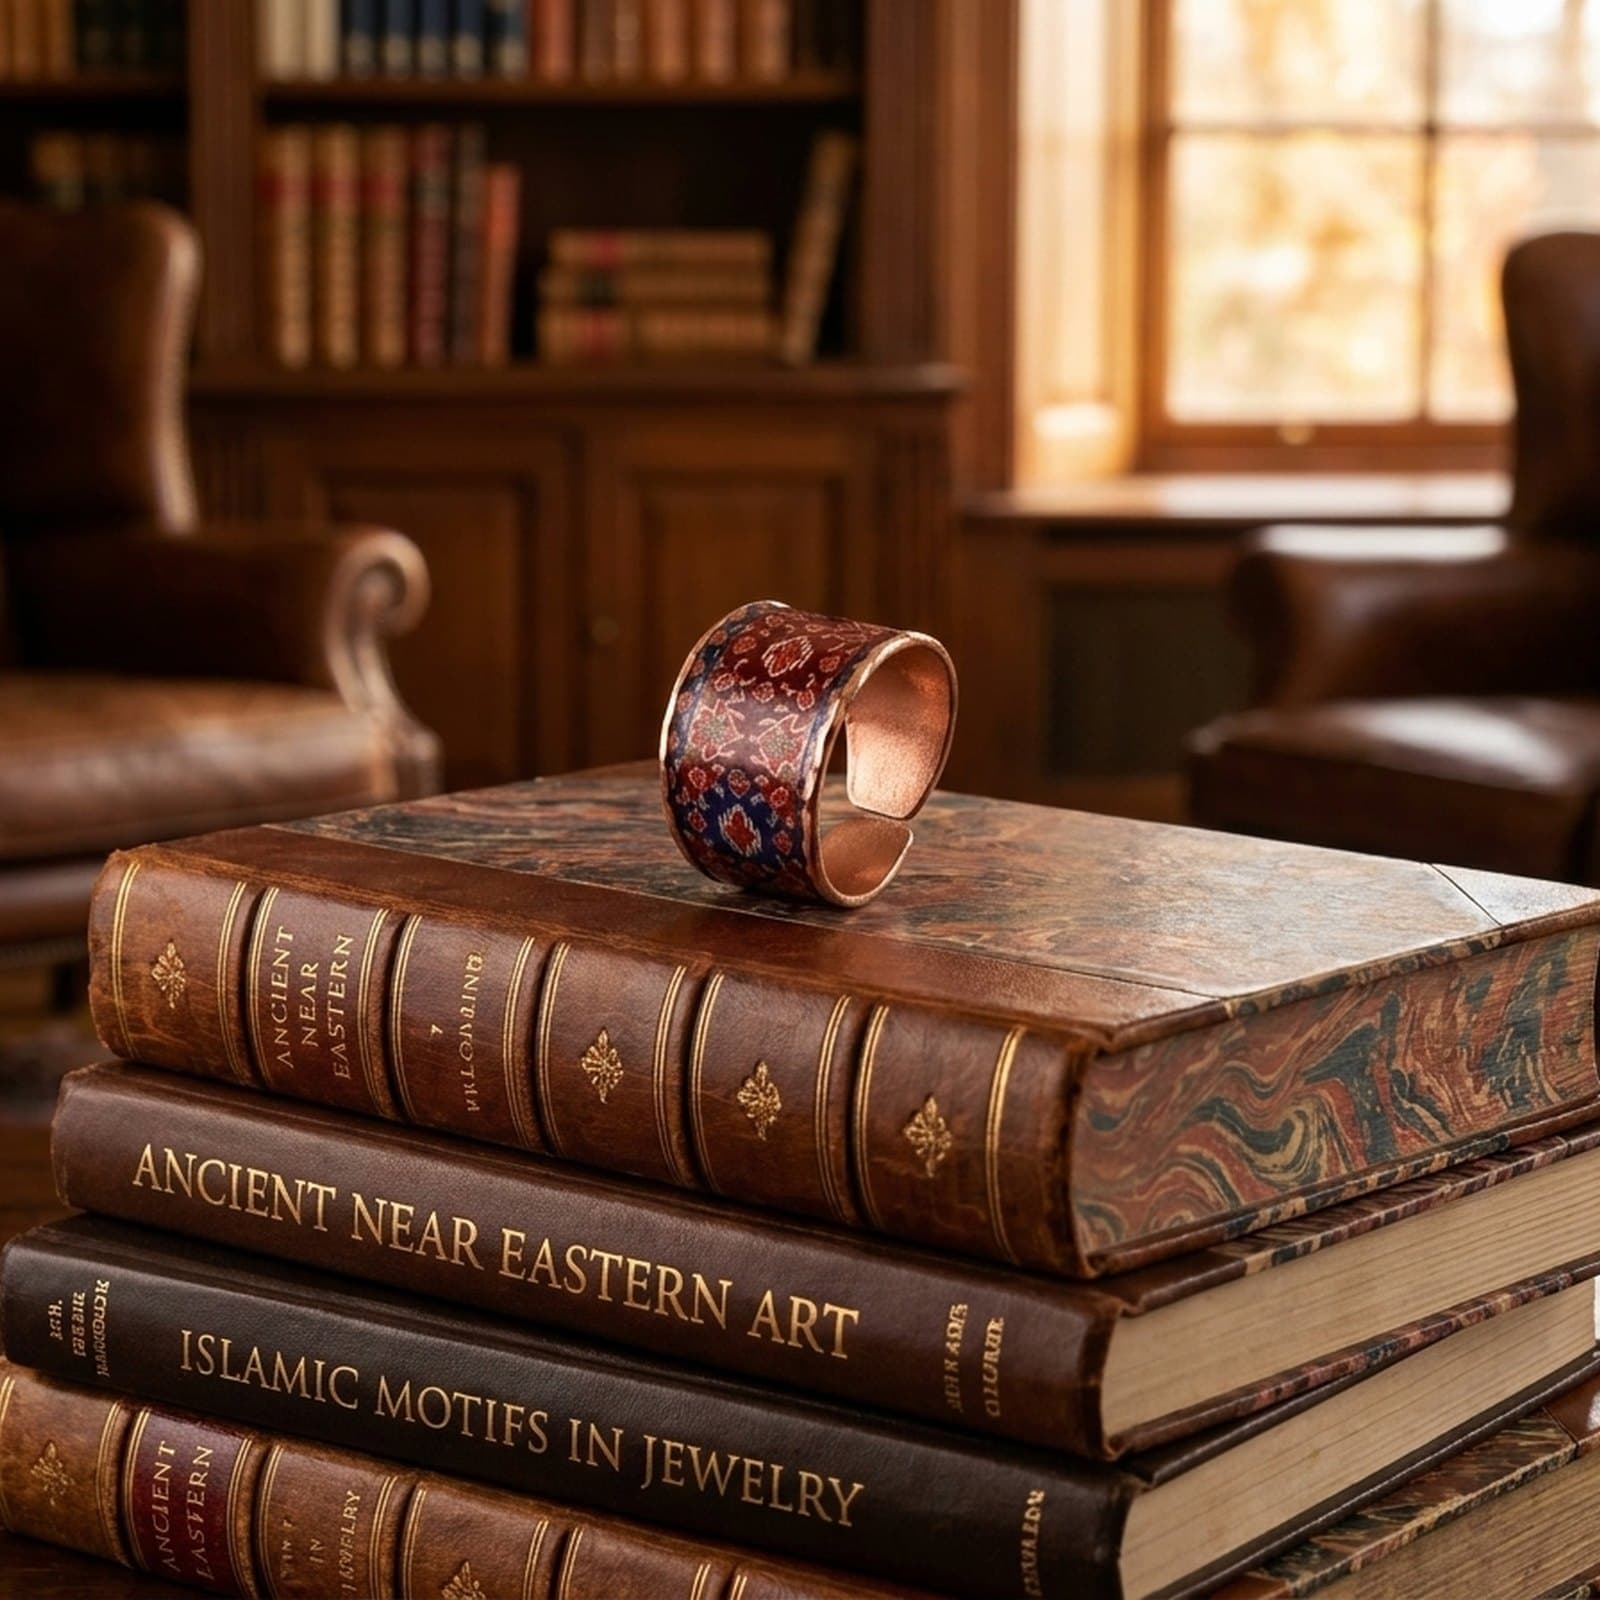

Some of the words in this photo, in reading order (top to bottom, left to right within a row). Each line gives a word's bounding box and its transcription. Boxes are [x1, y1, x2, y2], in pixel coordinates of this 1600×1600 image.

[271, 926, 294, 1069] ANCIENT
[300, 962, 319, 1047] NEAR
[327, 935, 353, 1080] EASTERN
[132, 1143, 336, 1232] ANCIENT
[351, 1192, 484, 1271] NEAR
[499, 1227, 733, 1330] EASTERN
[746, 1289, 860, 1360] ART
[180, 1329, 359, 1410] ISLAMIC
[373, 1375, 549, 1454] MOTIFS
[568, 1418, 624, 1472] IN
[640, 1434, 864, 1527] JEWELRY
[151, 1440, 181, 1573] ANCIENT
